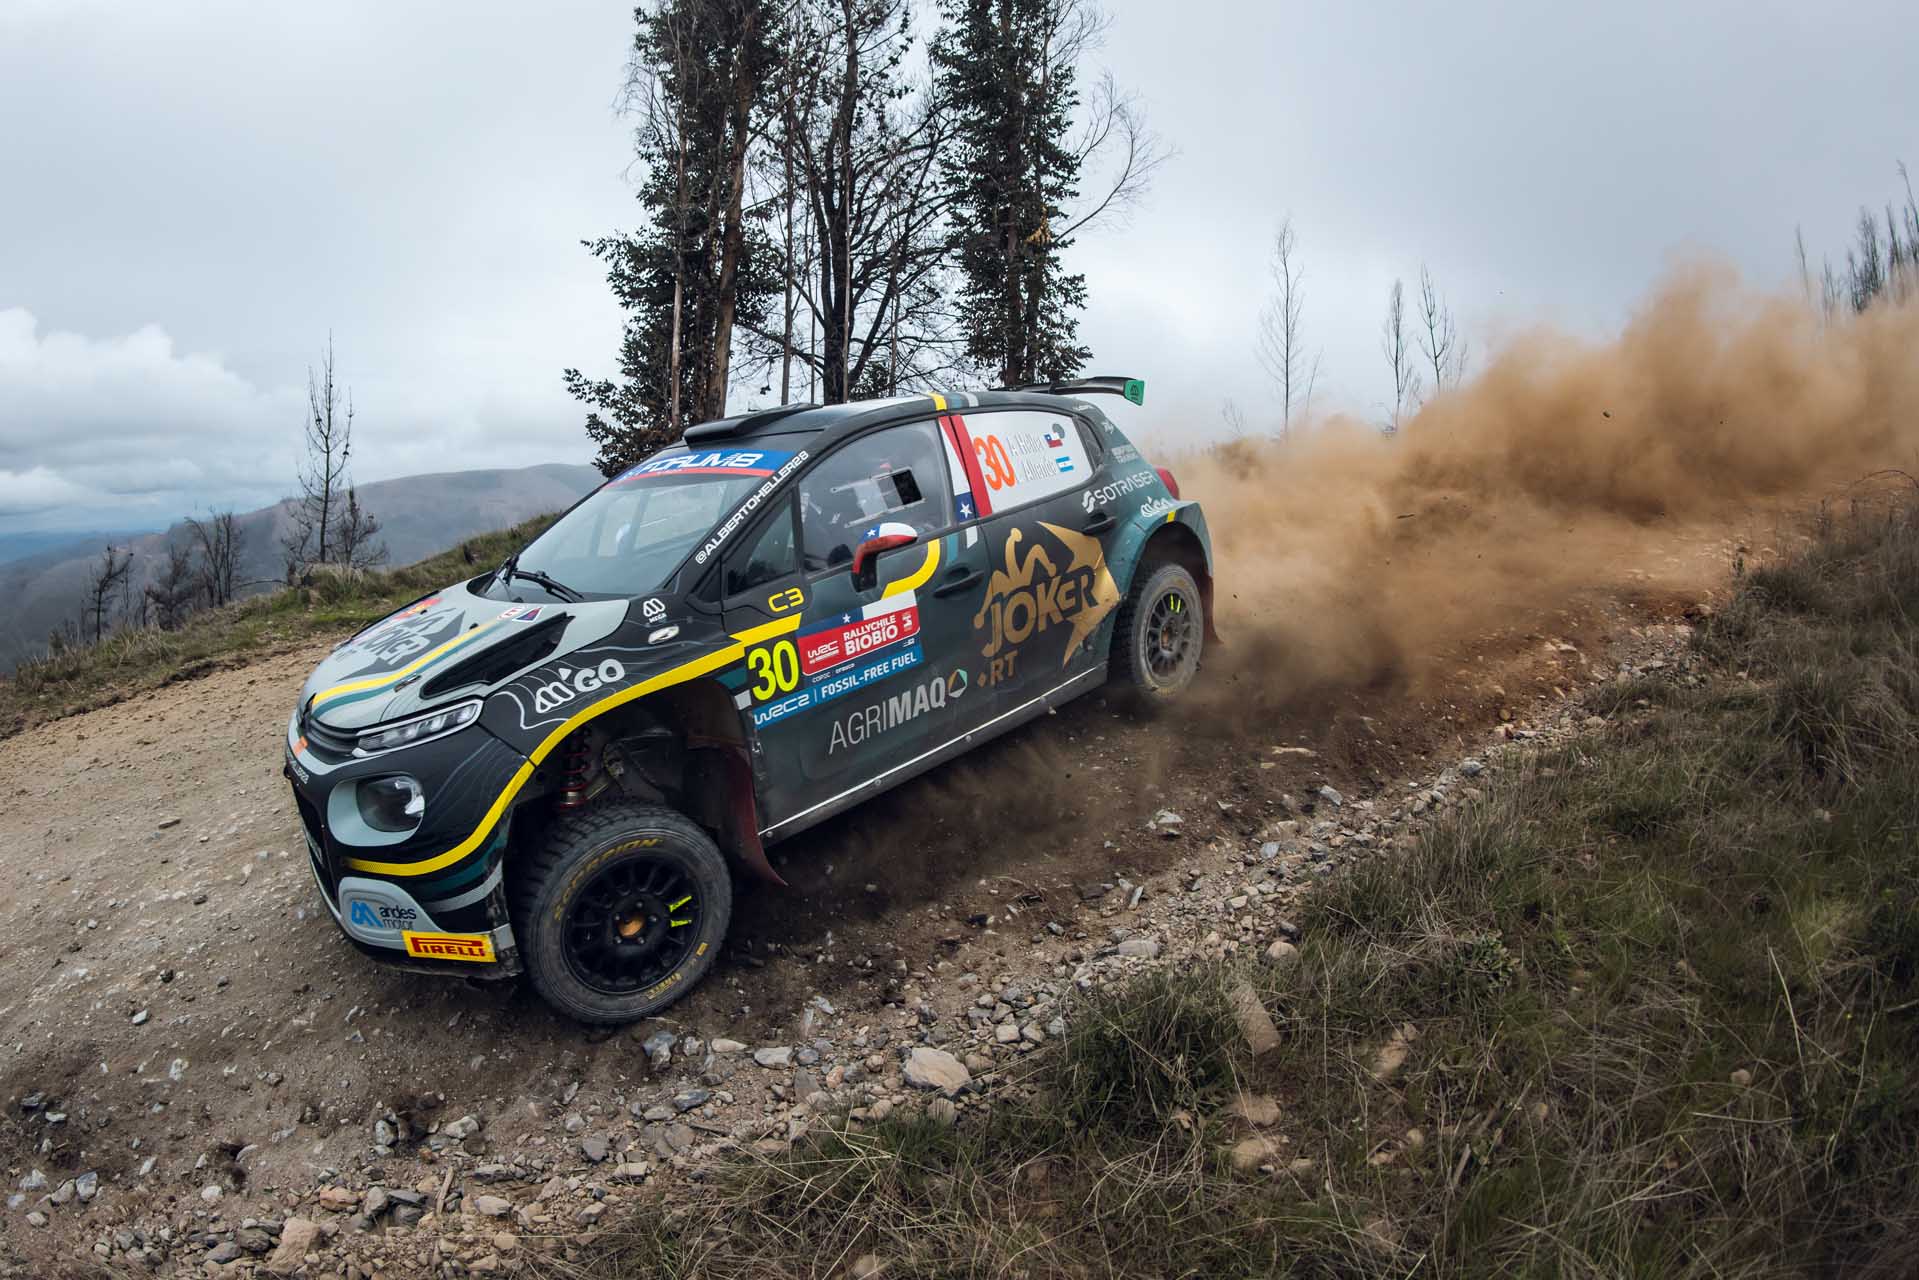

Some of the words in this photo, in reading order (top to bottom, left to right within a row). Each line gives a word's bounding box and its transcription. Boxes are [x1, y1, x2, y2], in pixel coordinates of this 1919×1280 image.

[973, 434, 1016, 490] 30
[695, 450, 809, 565] @ALBERTOHELLER28
[768, 587, 804, 613] C3
[981, 573, 1099, 658] JOKER
[747, 639, 800, 701] 30
[821, 661, 890, 699] FOSSIL-FREE
[891, 651, 918, 671] FUEL
[828, 676, 948, 755] AGRIMAQ
[379, 904, 417, 920] andes
[411, 936, 486, 957] PIRELLI
